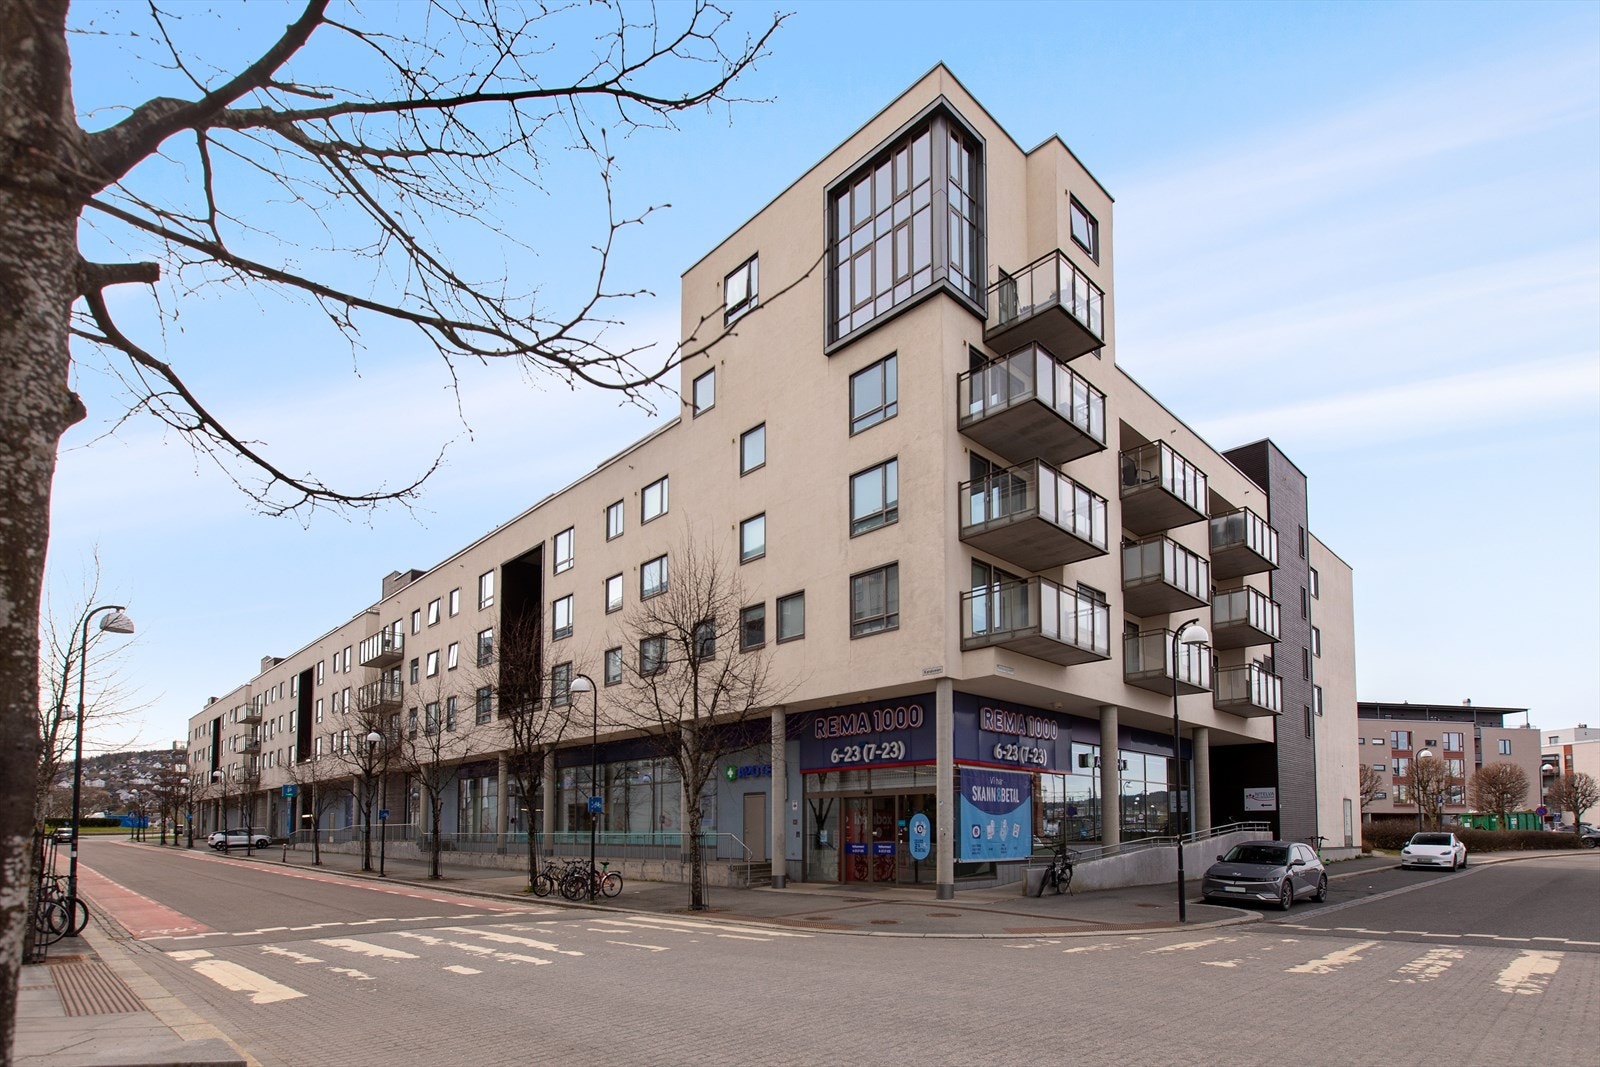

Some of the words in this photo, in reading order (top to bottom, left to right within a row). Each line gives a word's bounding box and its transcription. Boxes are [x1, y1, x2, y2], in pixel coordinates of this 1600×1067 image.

[814, 712, 871, 739] REMA
[873, 704, 924, 732] 1000
[980, 707, 1026, 736] REMA
[1026, 715, 1059, 740] 1000
[831, 745, 860, 763] 6-23
[863, 741, 906, 763] (7-23)
[994, 743, 1018, 760] 6-23
[1020, 746, 1047, 766] (7-23)
[738, 764, 772, 778] APOTE
